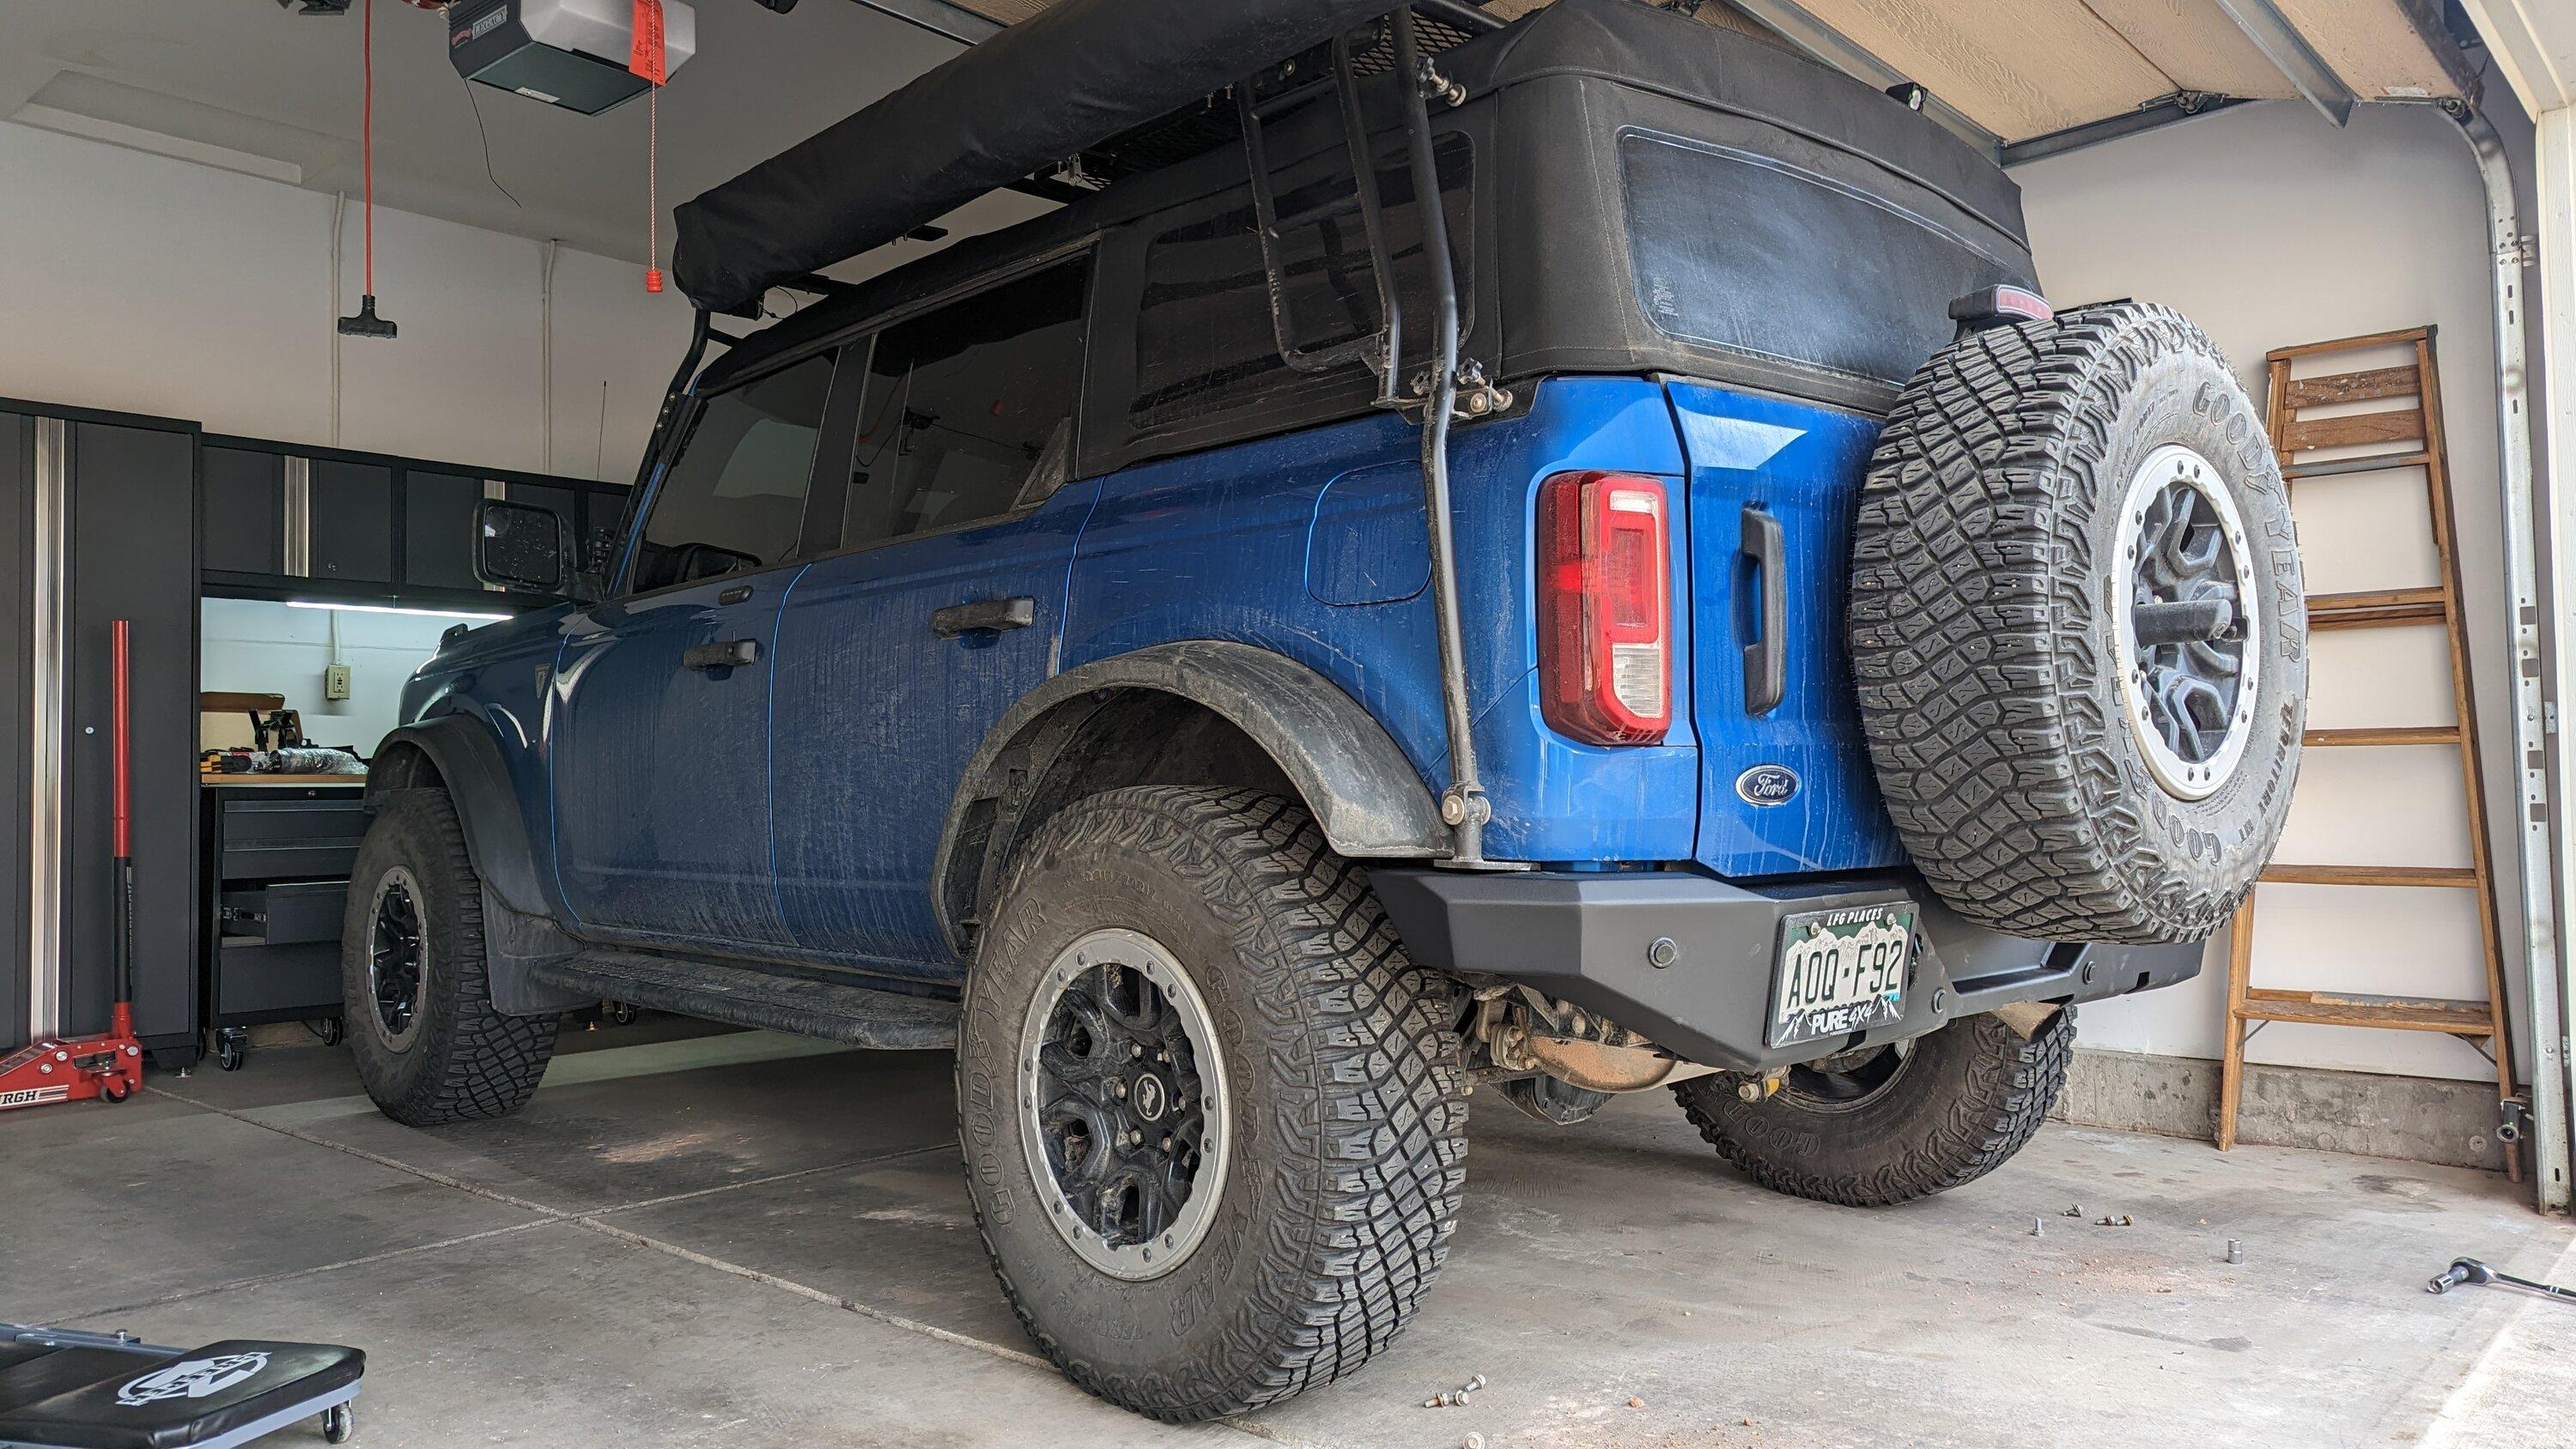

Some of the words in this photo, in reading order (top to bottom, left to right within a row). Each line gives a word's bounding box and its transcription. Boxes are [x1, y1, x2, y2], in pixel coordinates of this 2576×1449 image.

[2192, 381, 2301, 663] GOODYEAR
[1753, 773, 1789, 797] Ford
[2257, 702, 2293, 818] TERRITORY
[1826, 912, 1847, 927] LFG
[1846, 907, 1884, 925] PLACES
[1811, 1008, 1850, 1035] PURE
[968, 898, 1048, 1225] GOODYEAR
[118, 1352, 270, 1406] CREEPER
